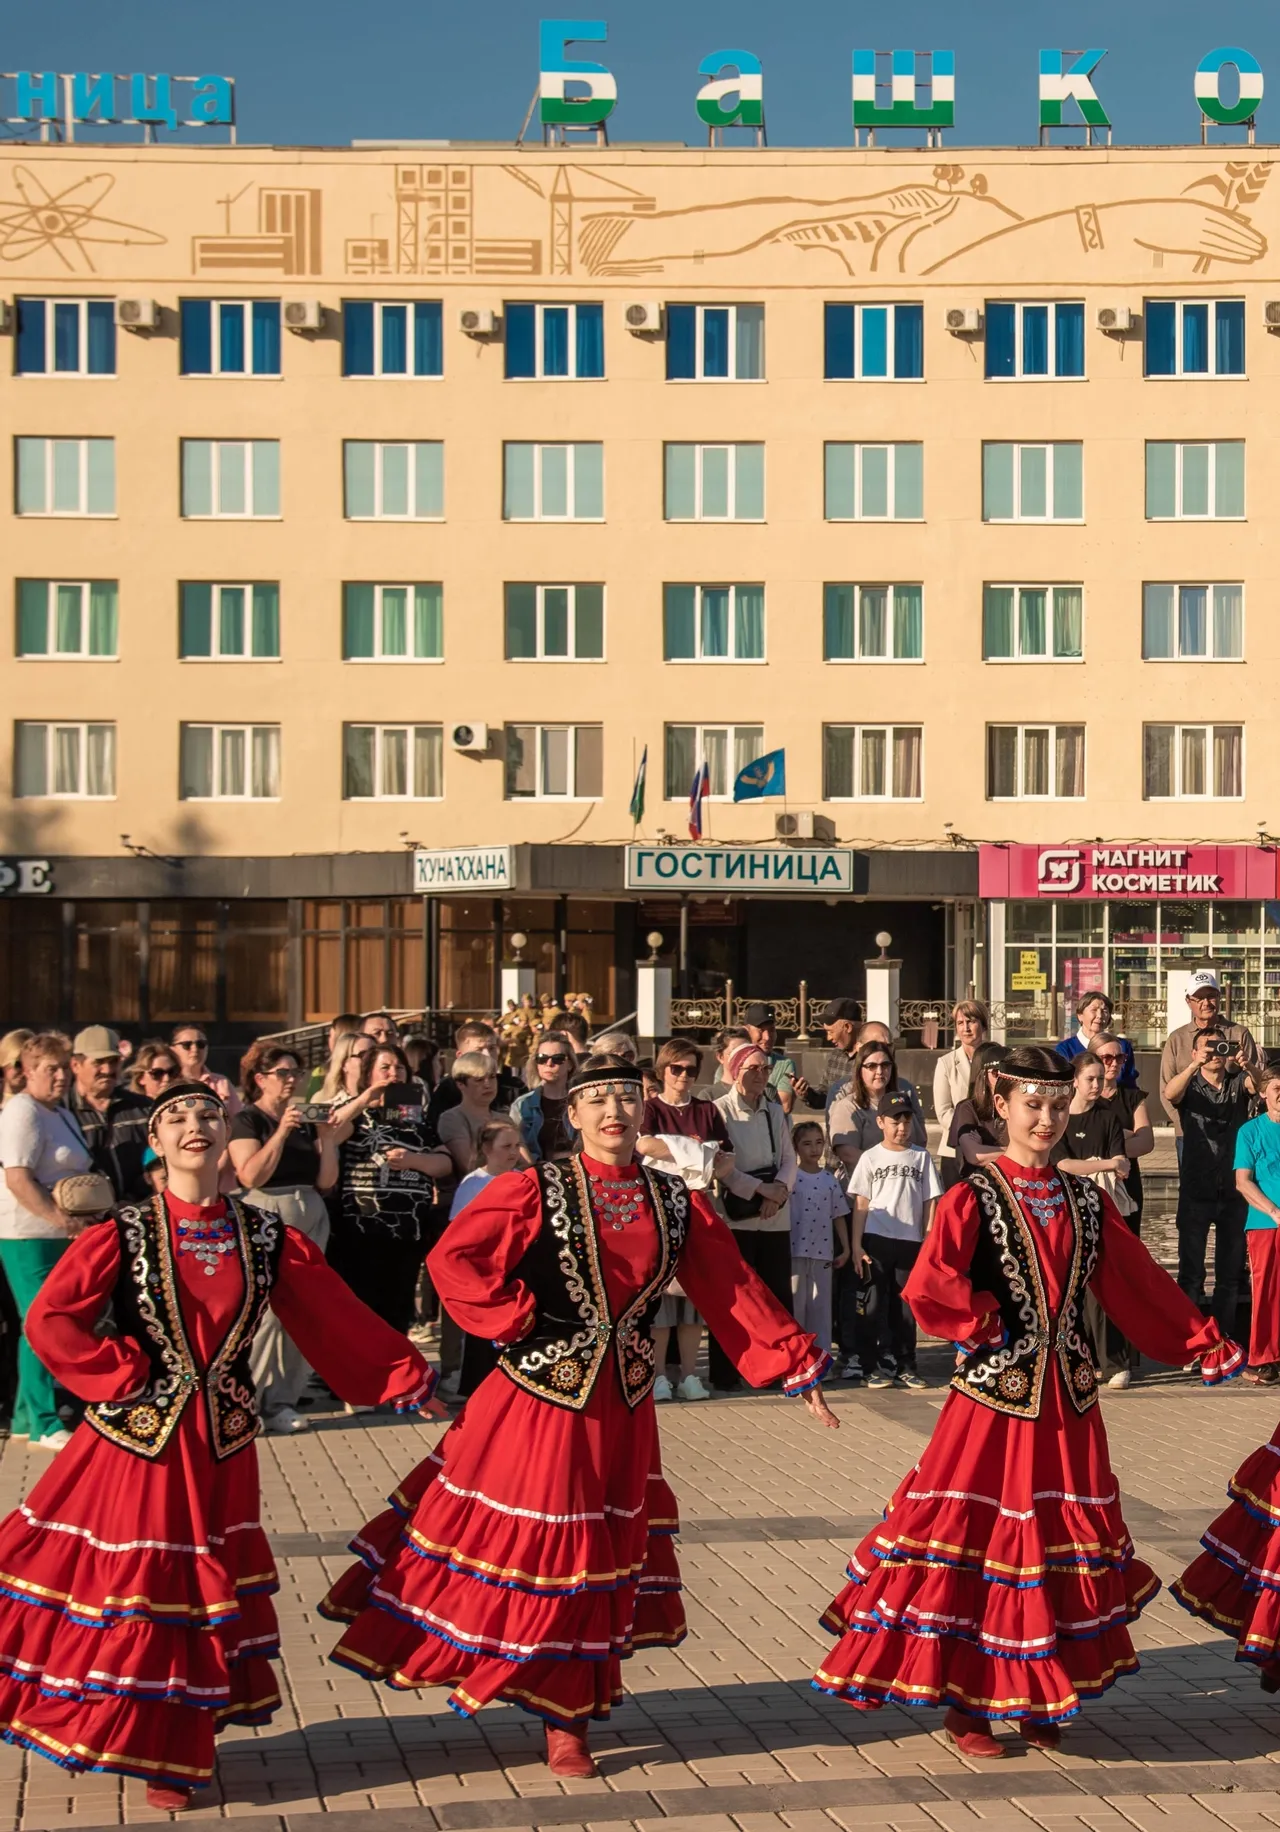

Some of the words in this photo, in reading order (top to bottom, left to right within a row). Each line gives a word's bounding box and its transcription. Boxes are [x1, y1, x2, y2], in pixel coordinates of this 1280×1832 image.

[16, 72, 233, 130] ница
[636, 852, 842, 885] ГОСТИНИЦА
[1092, 850, 1187, 867] МАГНИТ
[1092, 874, 1220, 892] КОСМЕТИК
